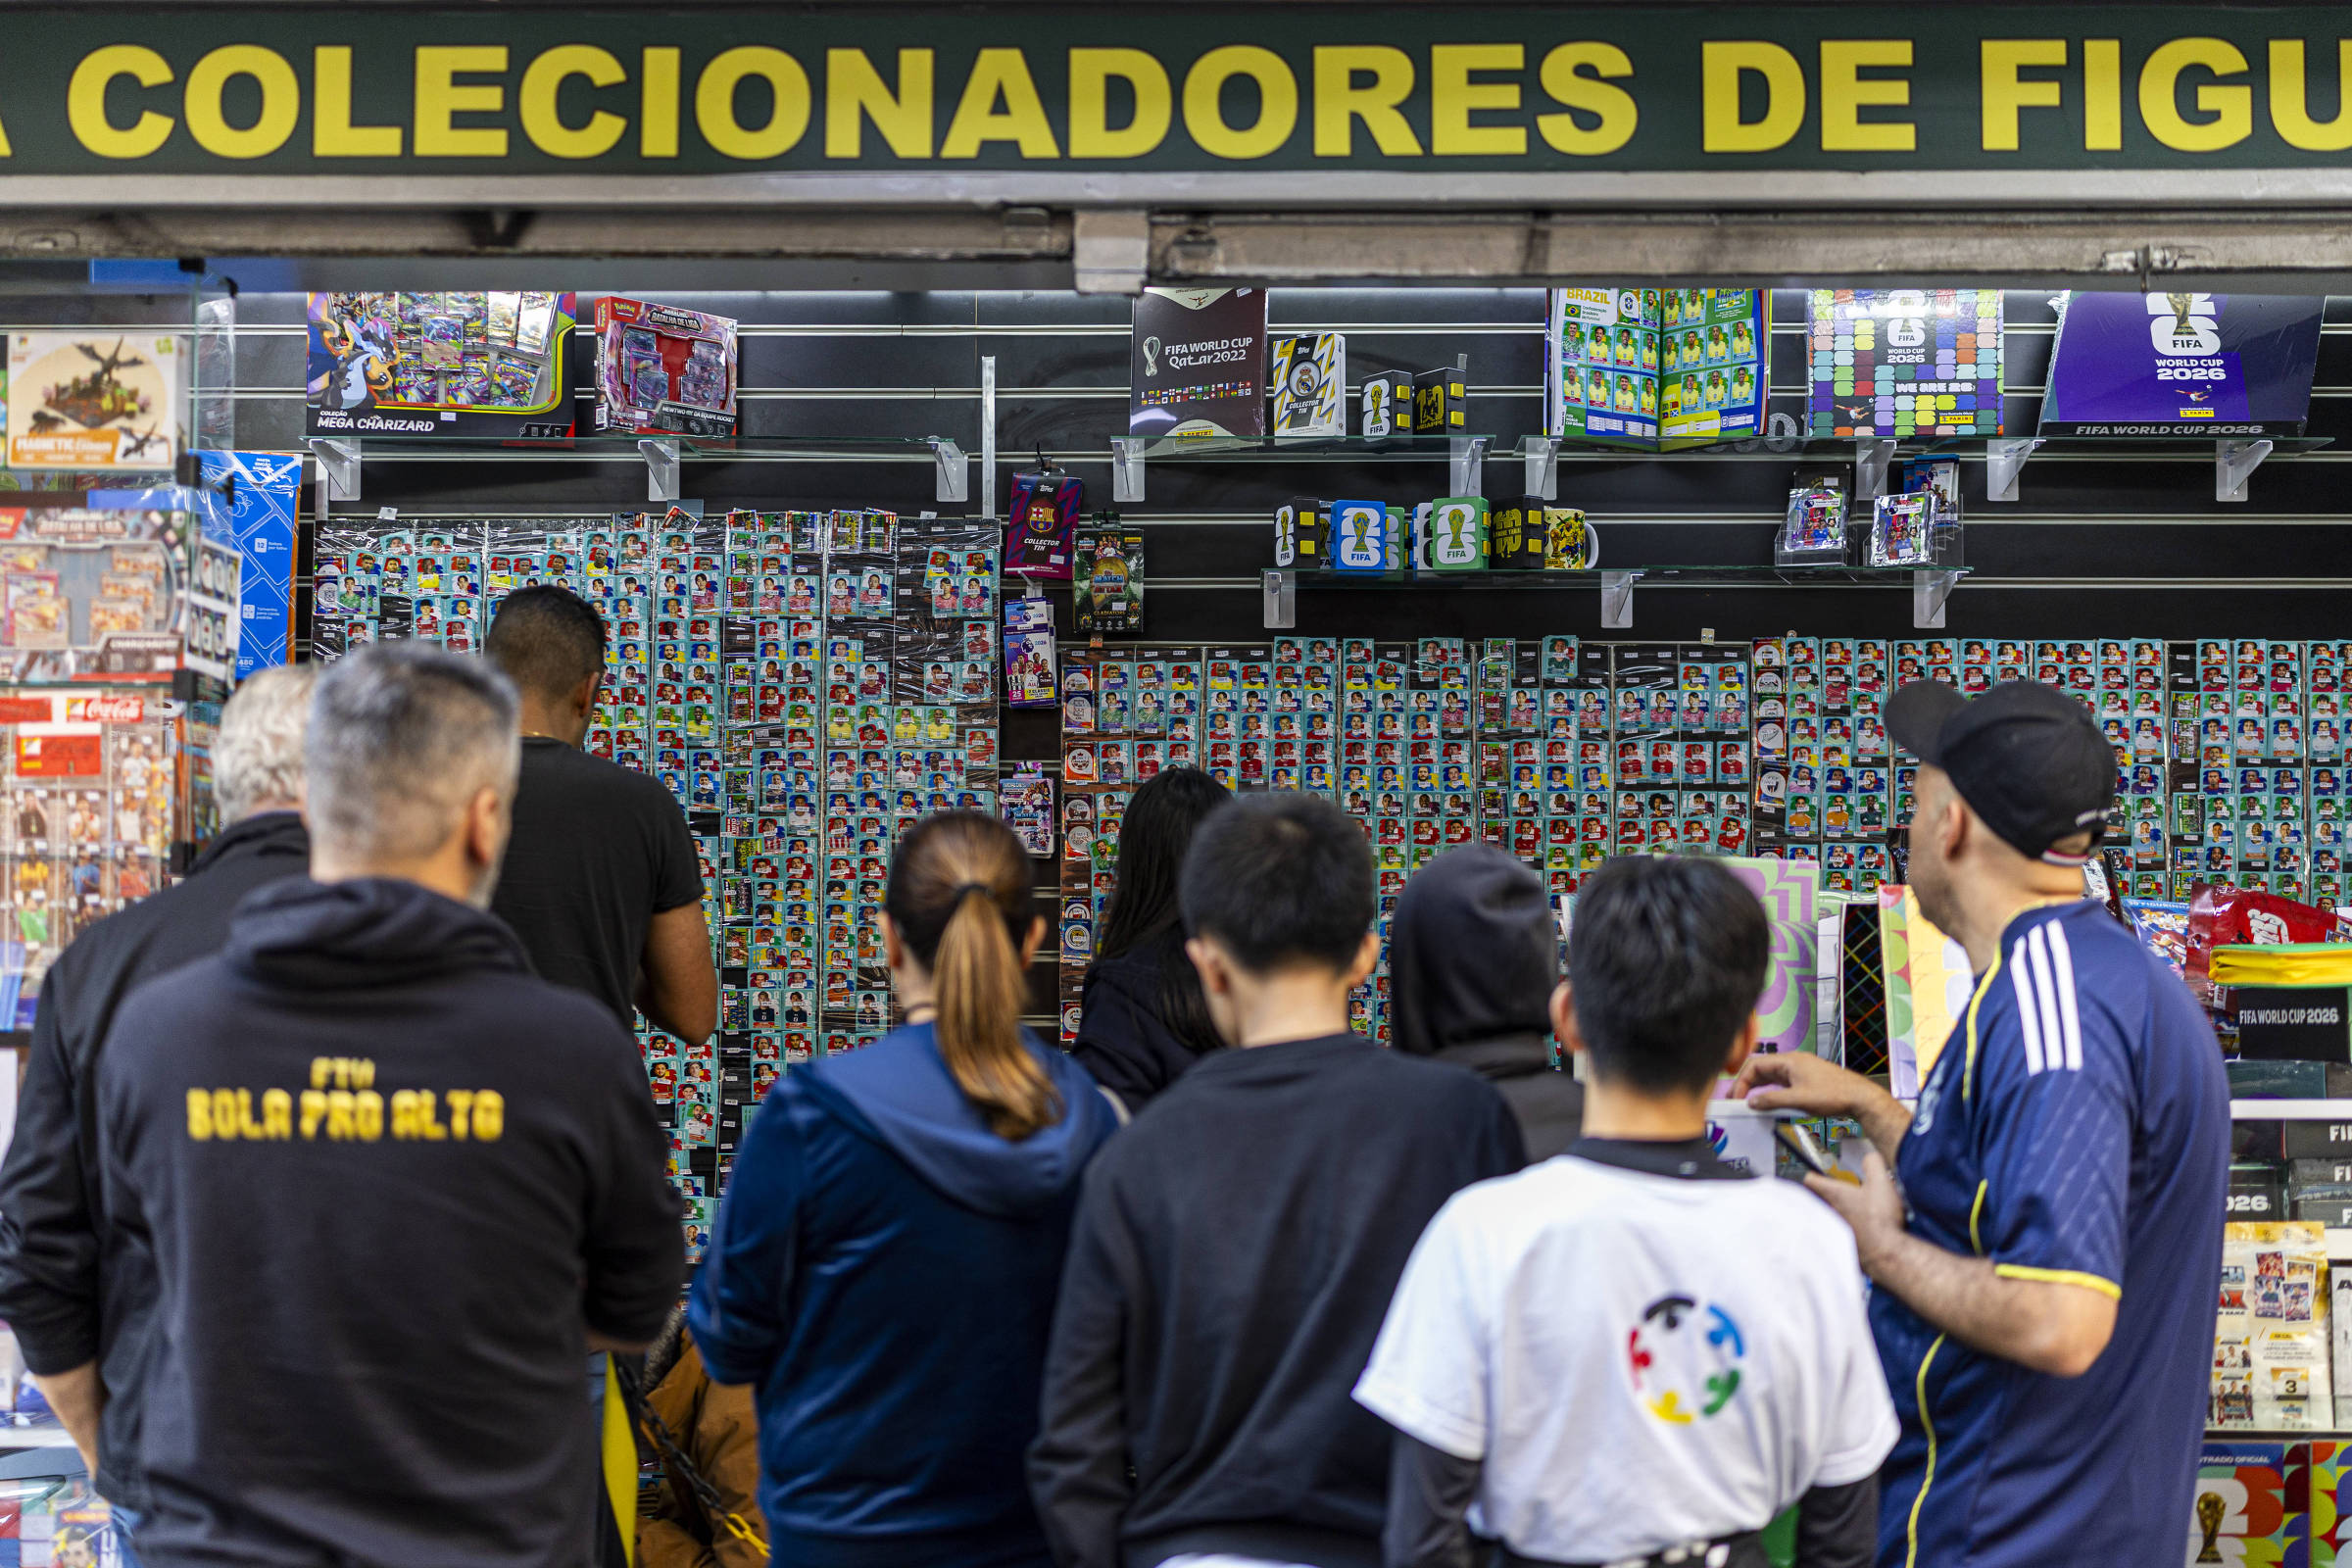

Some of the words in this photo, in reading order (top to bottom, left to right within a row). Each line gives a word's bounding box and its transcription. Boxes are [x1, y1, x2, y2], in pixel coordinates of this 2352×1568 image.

[68, 41, 1638, 159] COLECIONADORES
[1703, 41, 1916, 152] DE
[1982, 38, 2352, 151] FIGU
[1566, 287, 1611, 305] BRAZIL
[651, 313, 675, 324] BATALHA
[686, 318, 700, 330] LIGA
[1164, 346, 1188, 356] FIFA
[1189, 340, 1229, 353] WORLD
[1230, 337, 1252, 348] CUP
[2155, 359, 2199, 368] WORLD
[2157, 368, 2227, 380] 2026
[1896, 383, 1918, 392] WE
[1919, 383, 1946, 392] ARE
[1289, 400, 1320, 410] COLLECTOR
[662, 407, 686, 416] MEWTWO
[700, 412, 716, 420] EQUIPE
[716, 415, 736, 423] ROCKET
[318, 416, 354, 429] MEGA
[357, 416, 435, 432] CHARIZARD
[1370, 425, 1384, 434] FIFA
[2076, 426, 2110, 435] FIFA
[2112, 426, 2178, 435] WORLD
[2207, 425, 2263, 434] 2026
[1280, 552, 1290, 562] FIFA
[2239, 1009, 2257, 1024] FIFA
[2257, 1009, 2287, 1024] WORLD
[2288, 1008, 2306, 1024] CUP
[2307, 1007, 2339, 1023] 2026
[186, 1088, 292, 1141] BOLA
[299, 1089, 383, 1141] PRO
[391, 1089, 505, 1141] ALTO
[2285, 1380, 2297, 1394] 3
